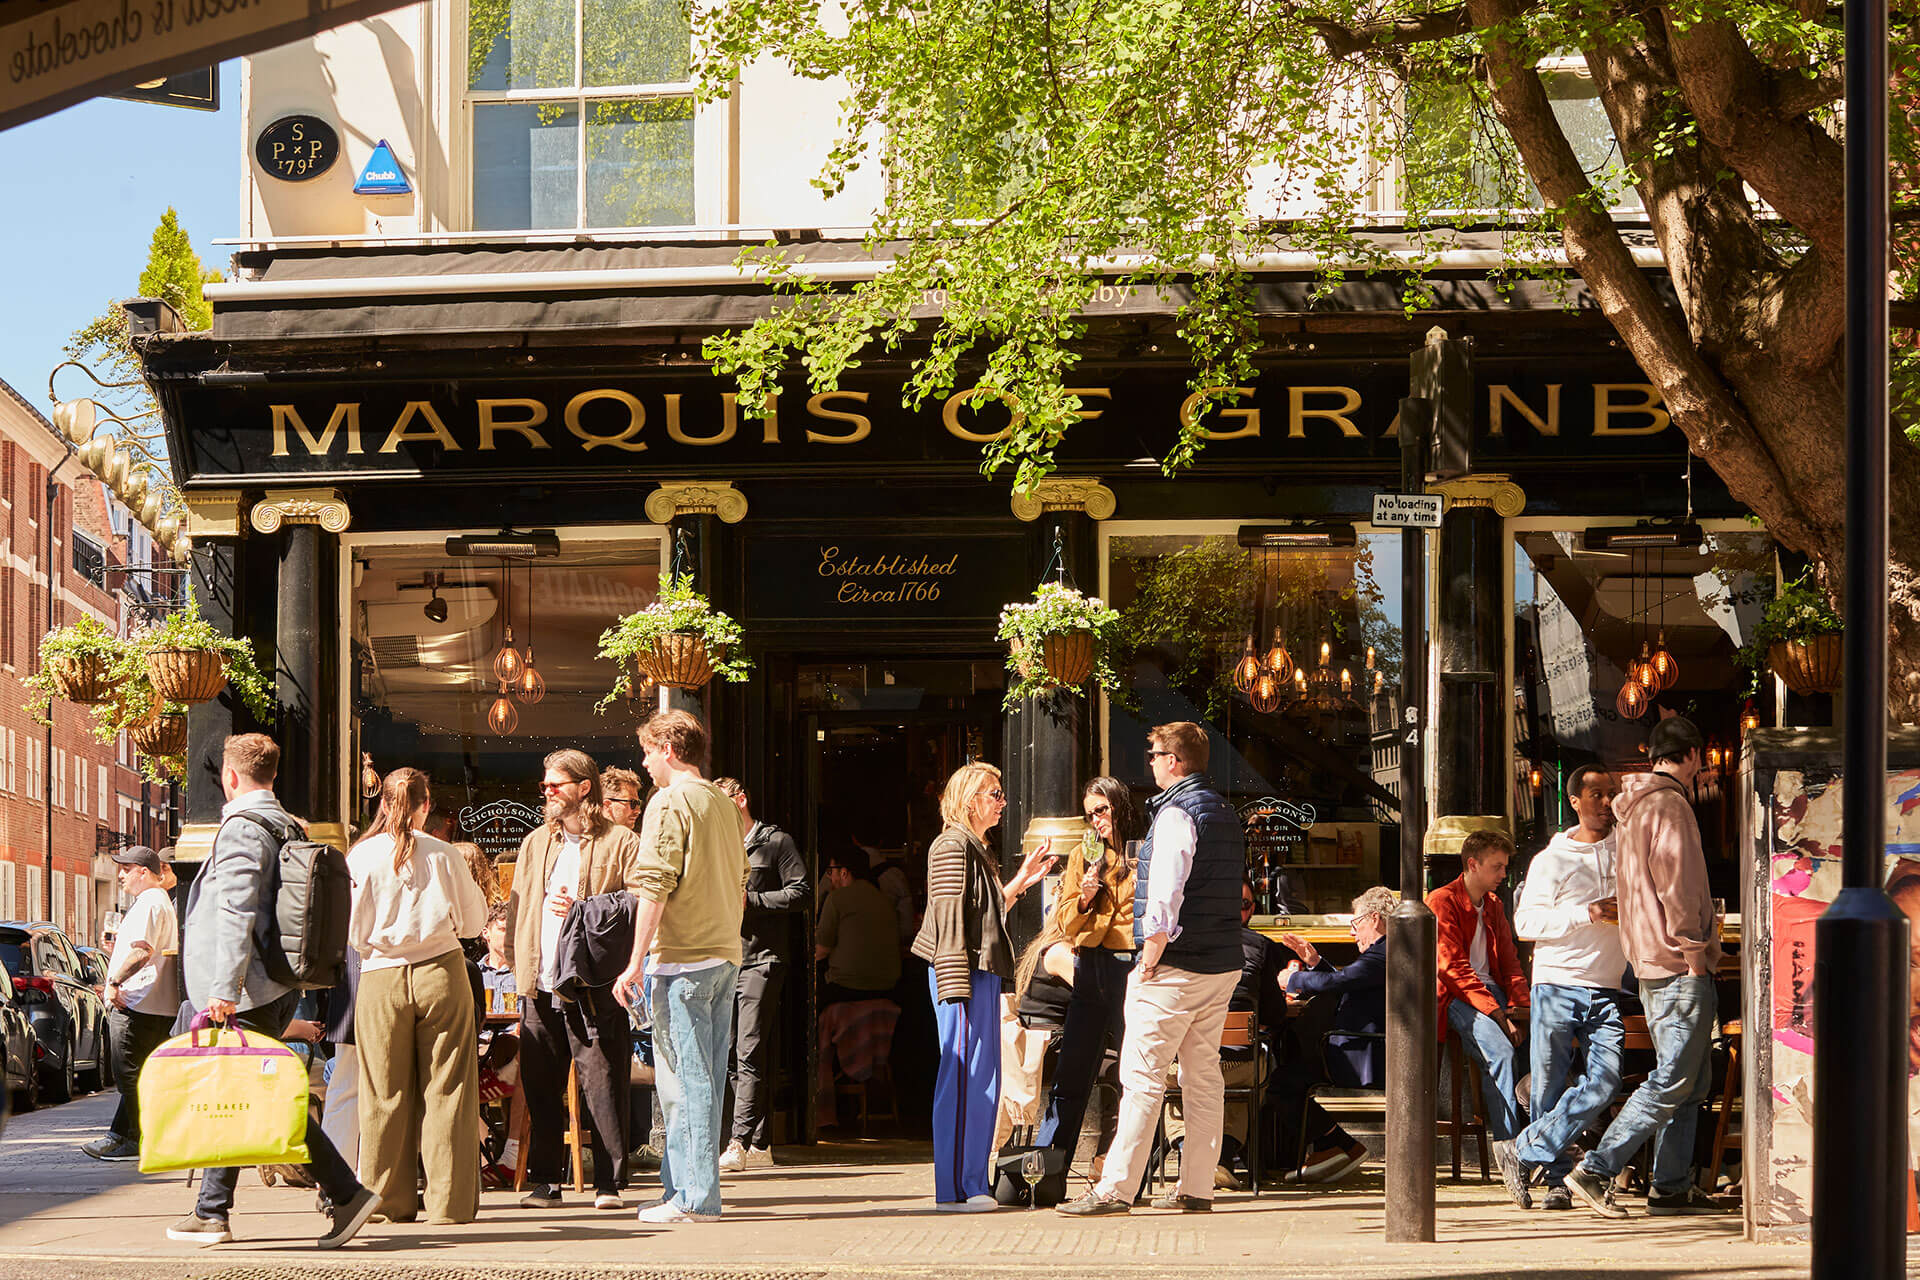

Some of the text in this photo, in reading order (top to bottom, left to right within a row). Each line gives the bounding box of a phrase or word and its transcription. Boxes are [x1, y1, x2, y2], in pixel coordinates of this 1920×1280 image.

[291, 123, 304, 141] S
[278, 158, 313, 175] 1791
[365, 171, 396, 181] Chubb
[269, 388, 872, 456] MARQUIS
[1178, 383, 1672, 440] GRNB
[1378, 498, 1437, 511] No loading
[1376, 511, 1437, 523] at any time
[818, 545, 959, 576] Established
[837, 580, 941, 603] Circa 1766
[468, 807, 541, 825] NICHOLSON'S
